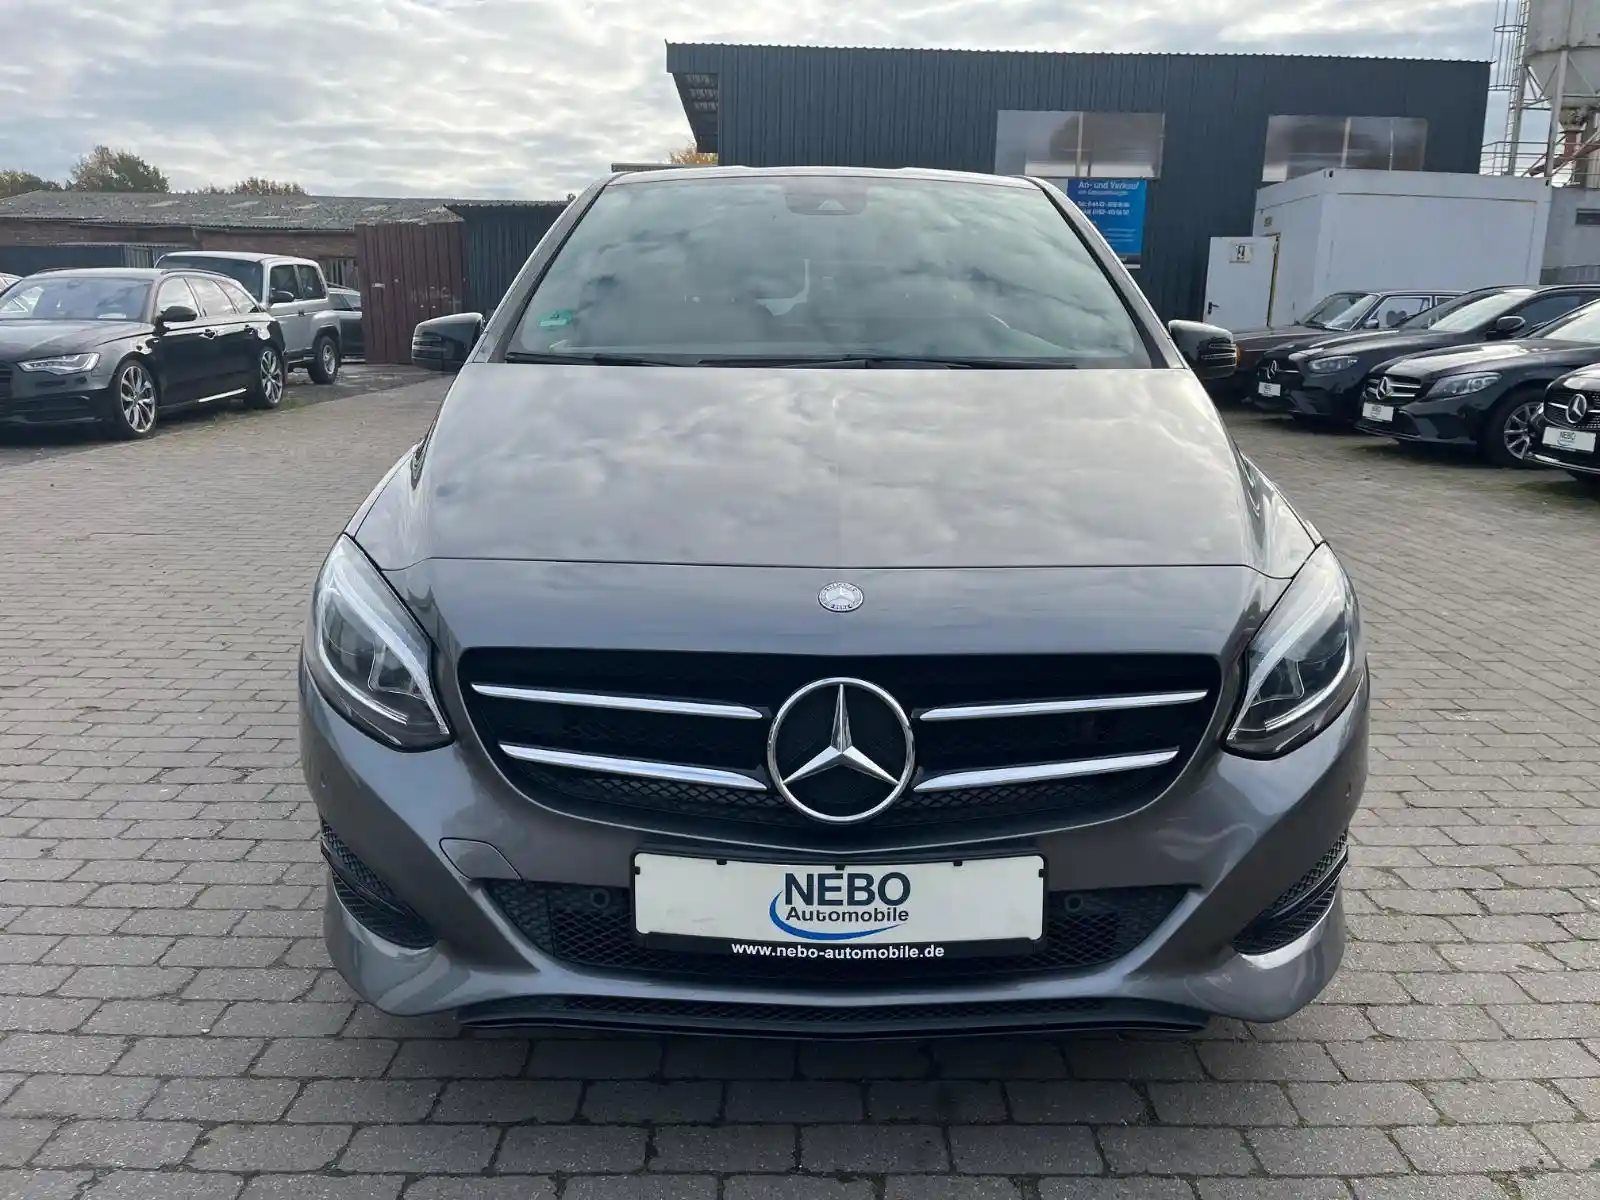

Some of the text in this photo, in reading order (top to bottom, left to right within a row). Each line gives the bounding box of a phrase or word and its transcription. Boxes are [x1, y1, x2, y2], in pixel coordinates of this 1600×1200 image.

[1093, 181, 1108, 189] und
[1110, 181, 1139, 190] Verkauf
[785, 872, 911, 906] NEBO
[785, 906, 909, 922] Automobile
[731, 943, 945, 959] www.nebo-automobile.de
